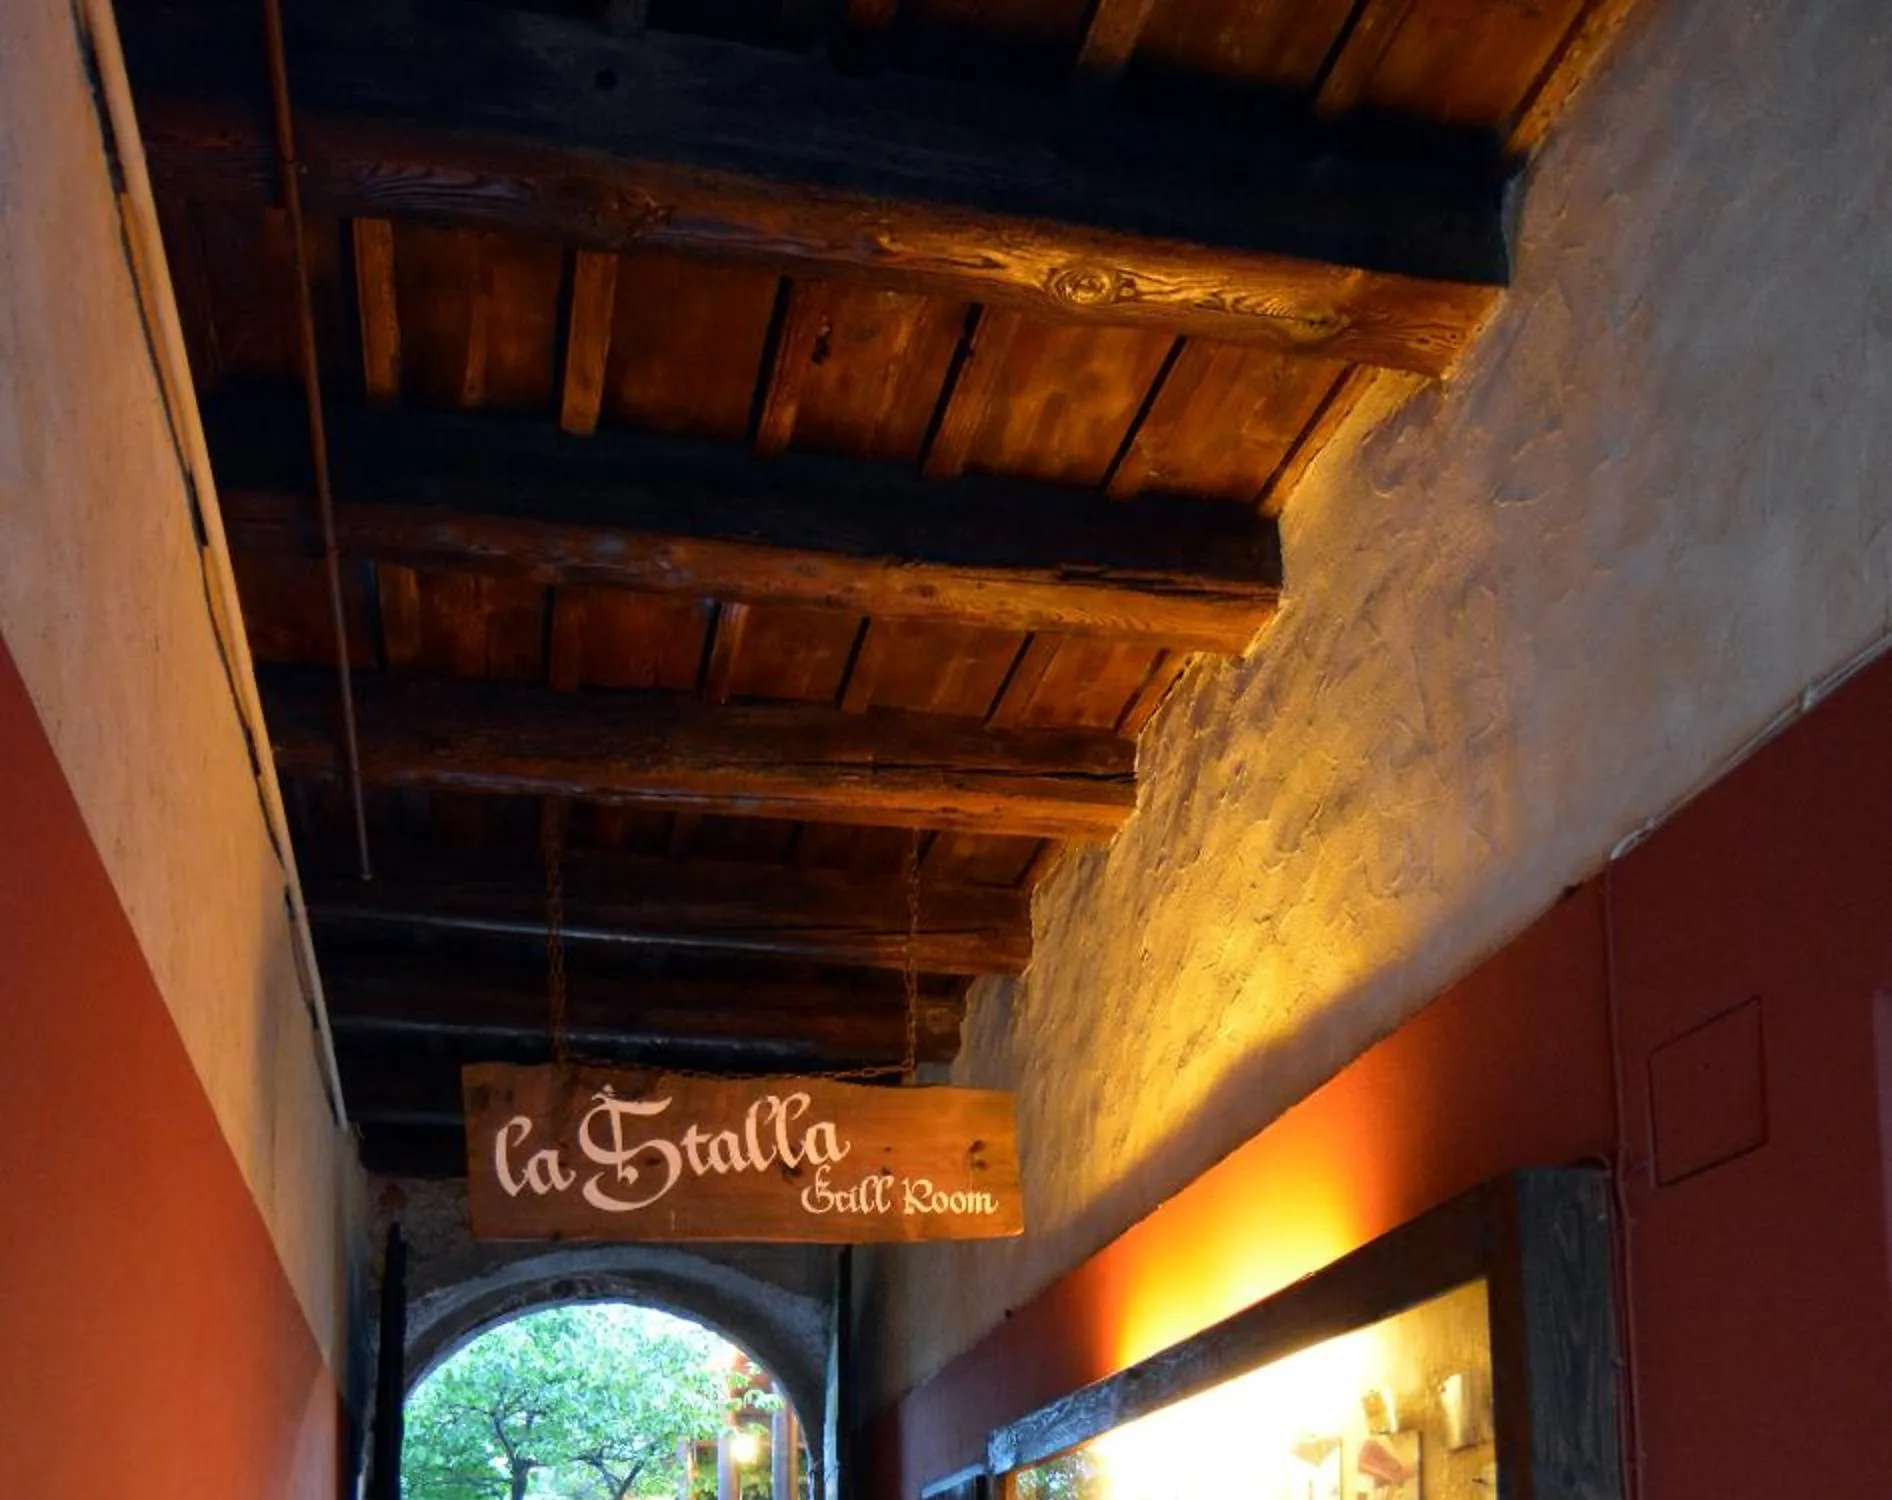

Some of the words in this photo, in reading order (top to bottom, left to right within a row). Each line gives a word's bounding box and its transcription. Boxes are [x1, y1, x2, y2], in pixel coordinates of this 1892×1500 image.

[578, 1084, 851, 1212] Stalla
[801, 1164, 895, 1214] Grill
[901, 1177, 999, 1214] Room
